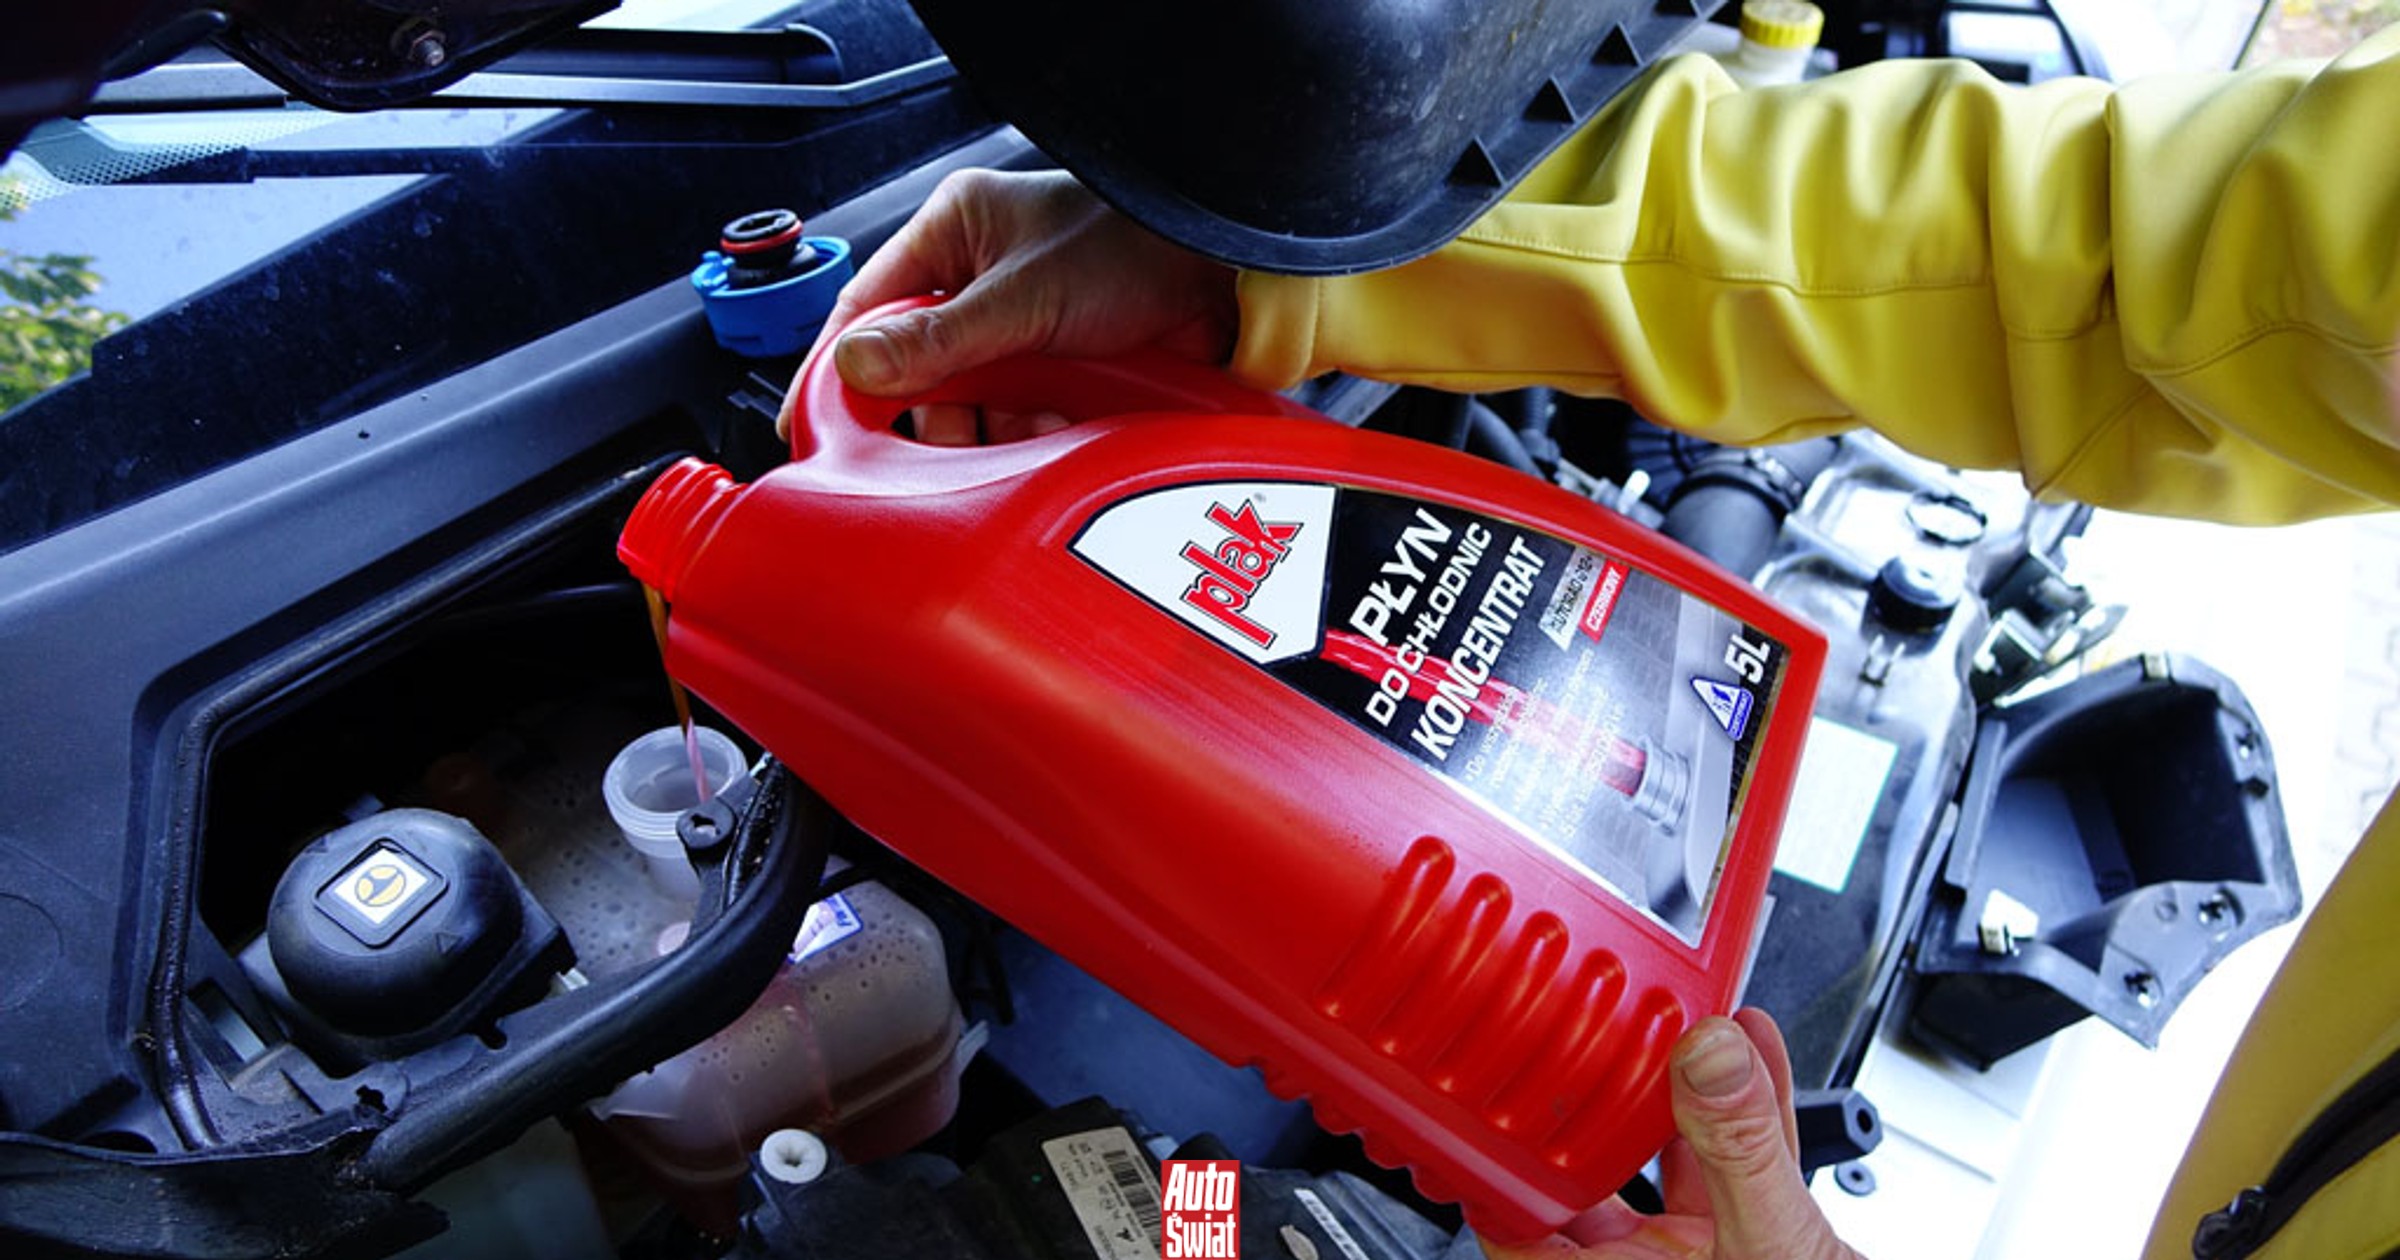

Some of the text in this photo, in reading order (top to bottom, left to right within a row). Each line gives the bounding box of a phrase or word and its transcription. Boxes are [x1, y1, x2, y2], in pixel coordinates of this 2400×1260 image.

[1179, 498, 1304, 650] plak
[1348, 507, 1453, 648] PŁYN
[1364, 522, 1493, 728] DO CHŁODNIC
[1410, 534, 1546, 762] KONCENTRAT
[1724, 633, 1771, 685] 5L
